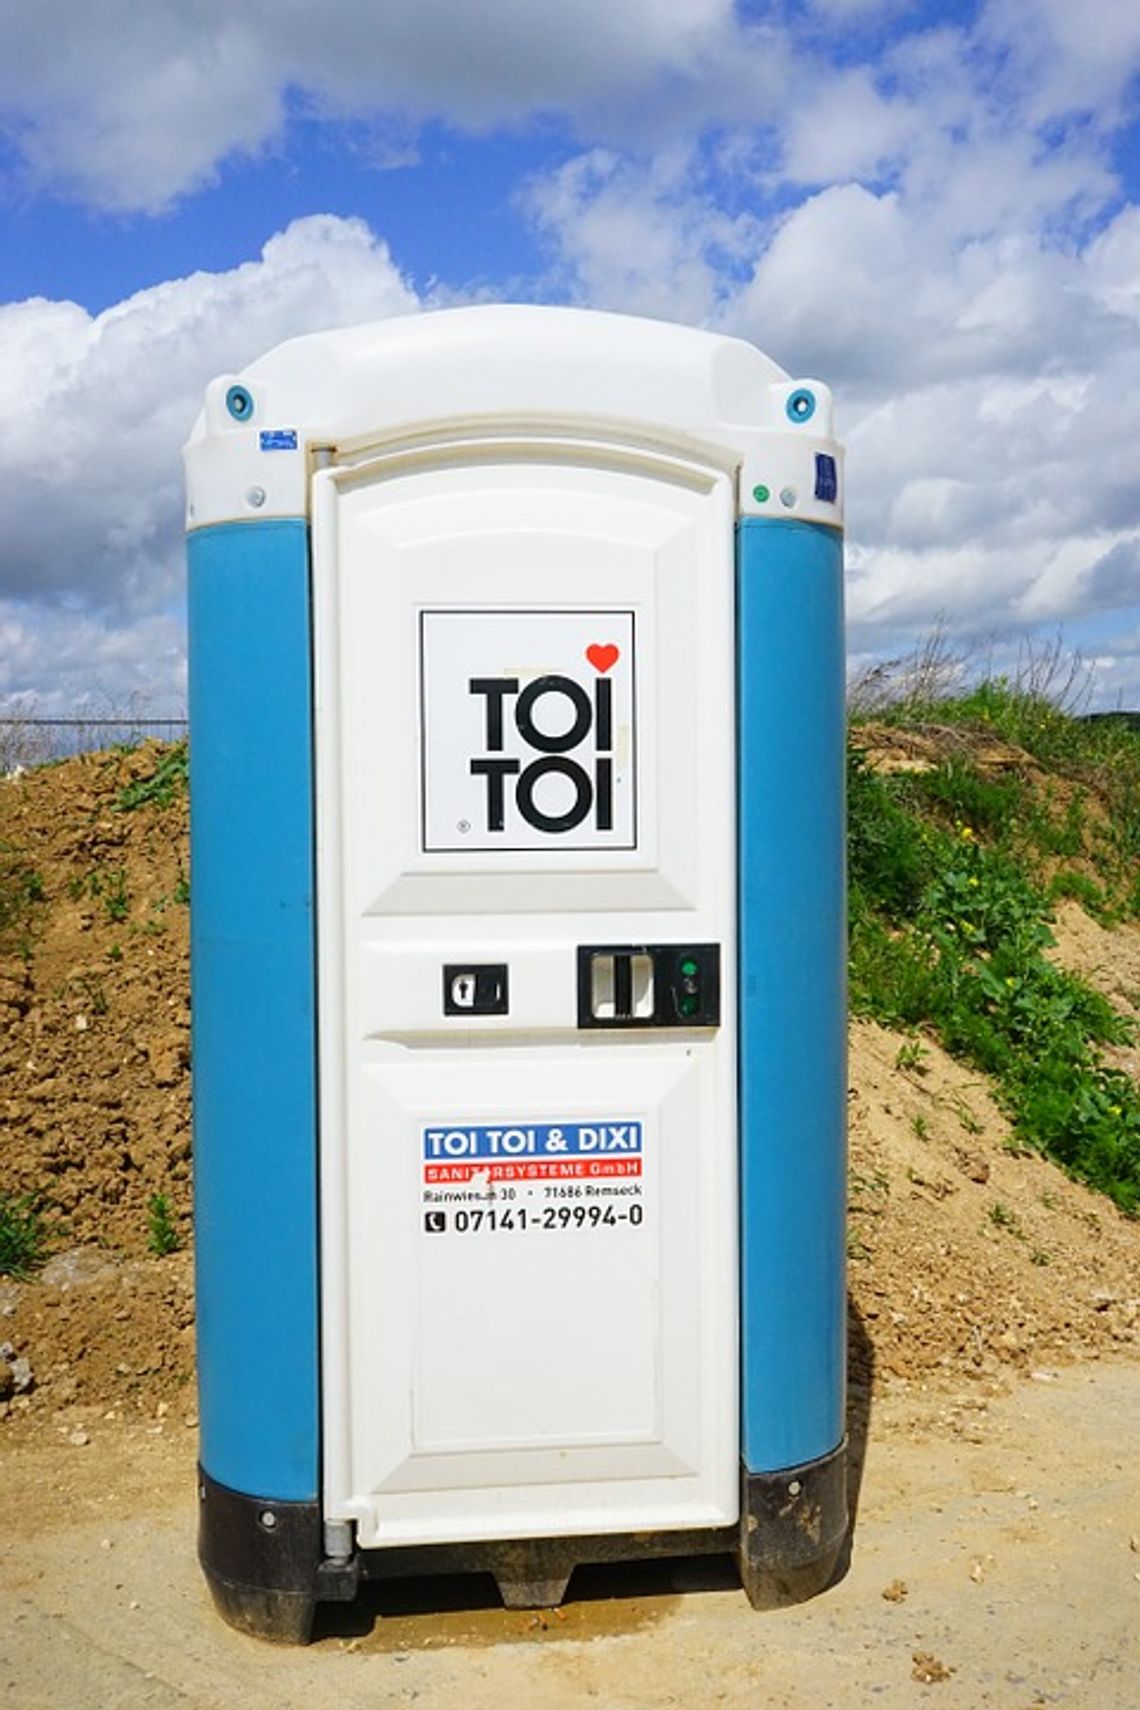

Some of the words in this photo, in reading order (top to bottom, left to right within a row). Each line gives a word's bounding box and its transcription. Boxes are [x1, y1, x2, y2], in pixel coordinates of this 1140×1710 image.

[469, 675, 612, 753] TOI
[470, 755, 612, 833] TOI
[428, 1131, 477, 1155] TOI
[487, 1130, 535, 1153] TOI
[545, 1128, 568, 1151] &
[579, 1126, 638, 1150] DIXI
[455, 1204, 643, 1232] 07141-29994-0
